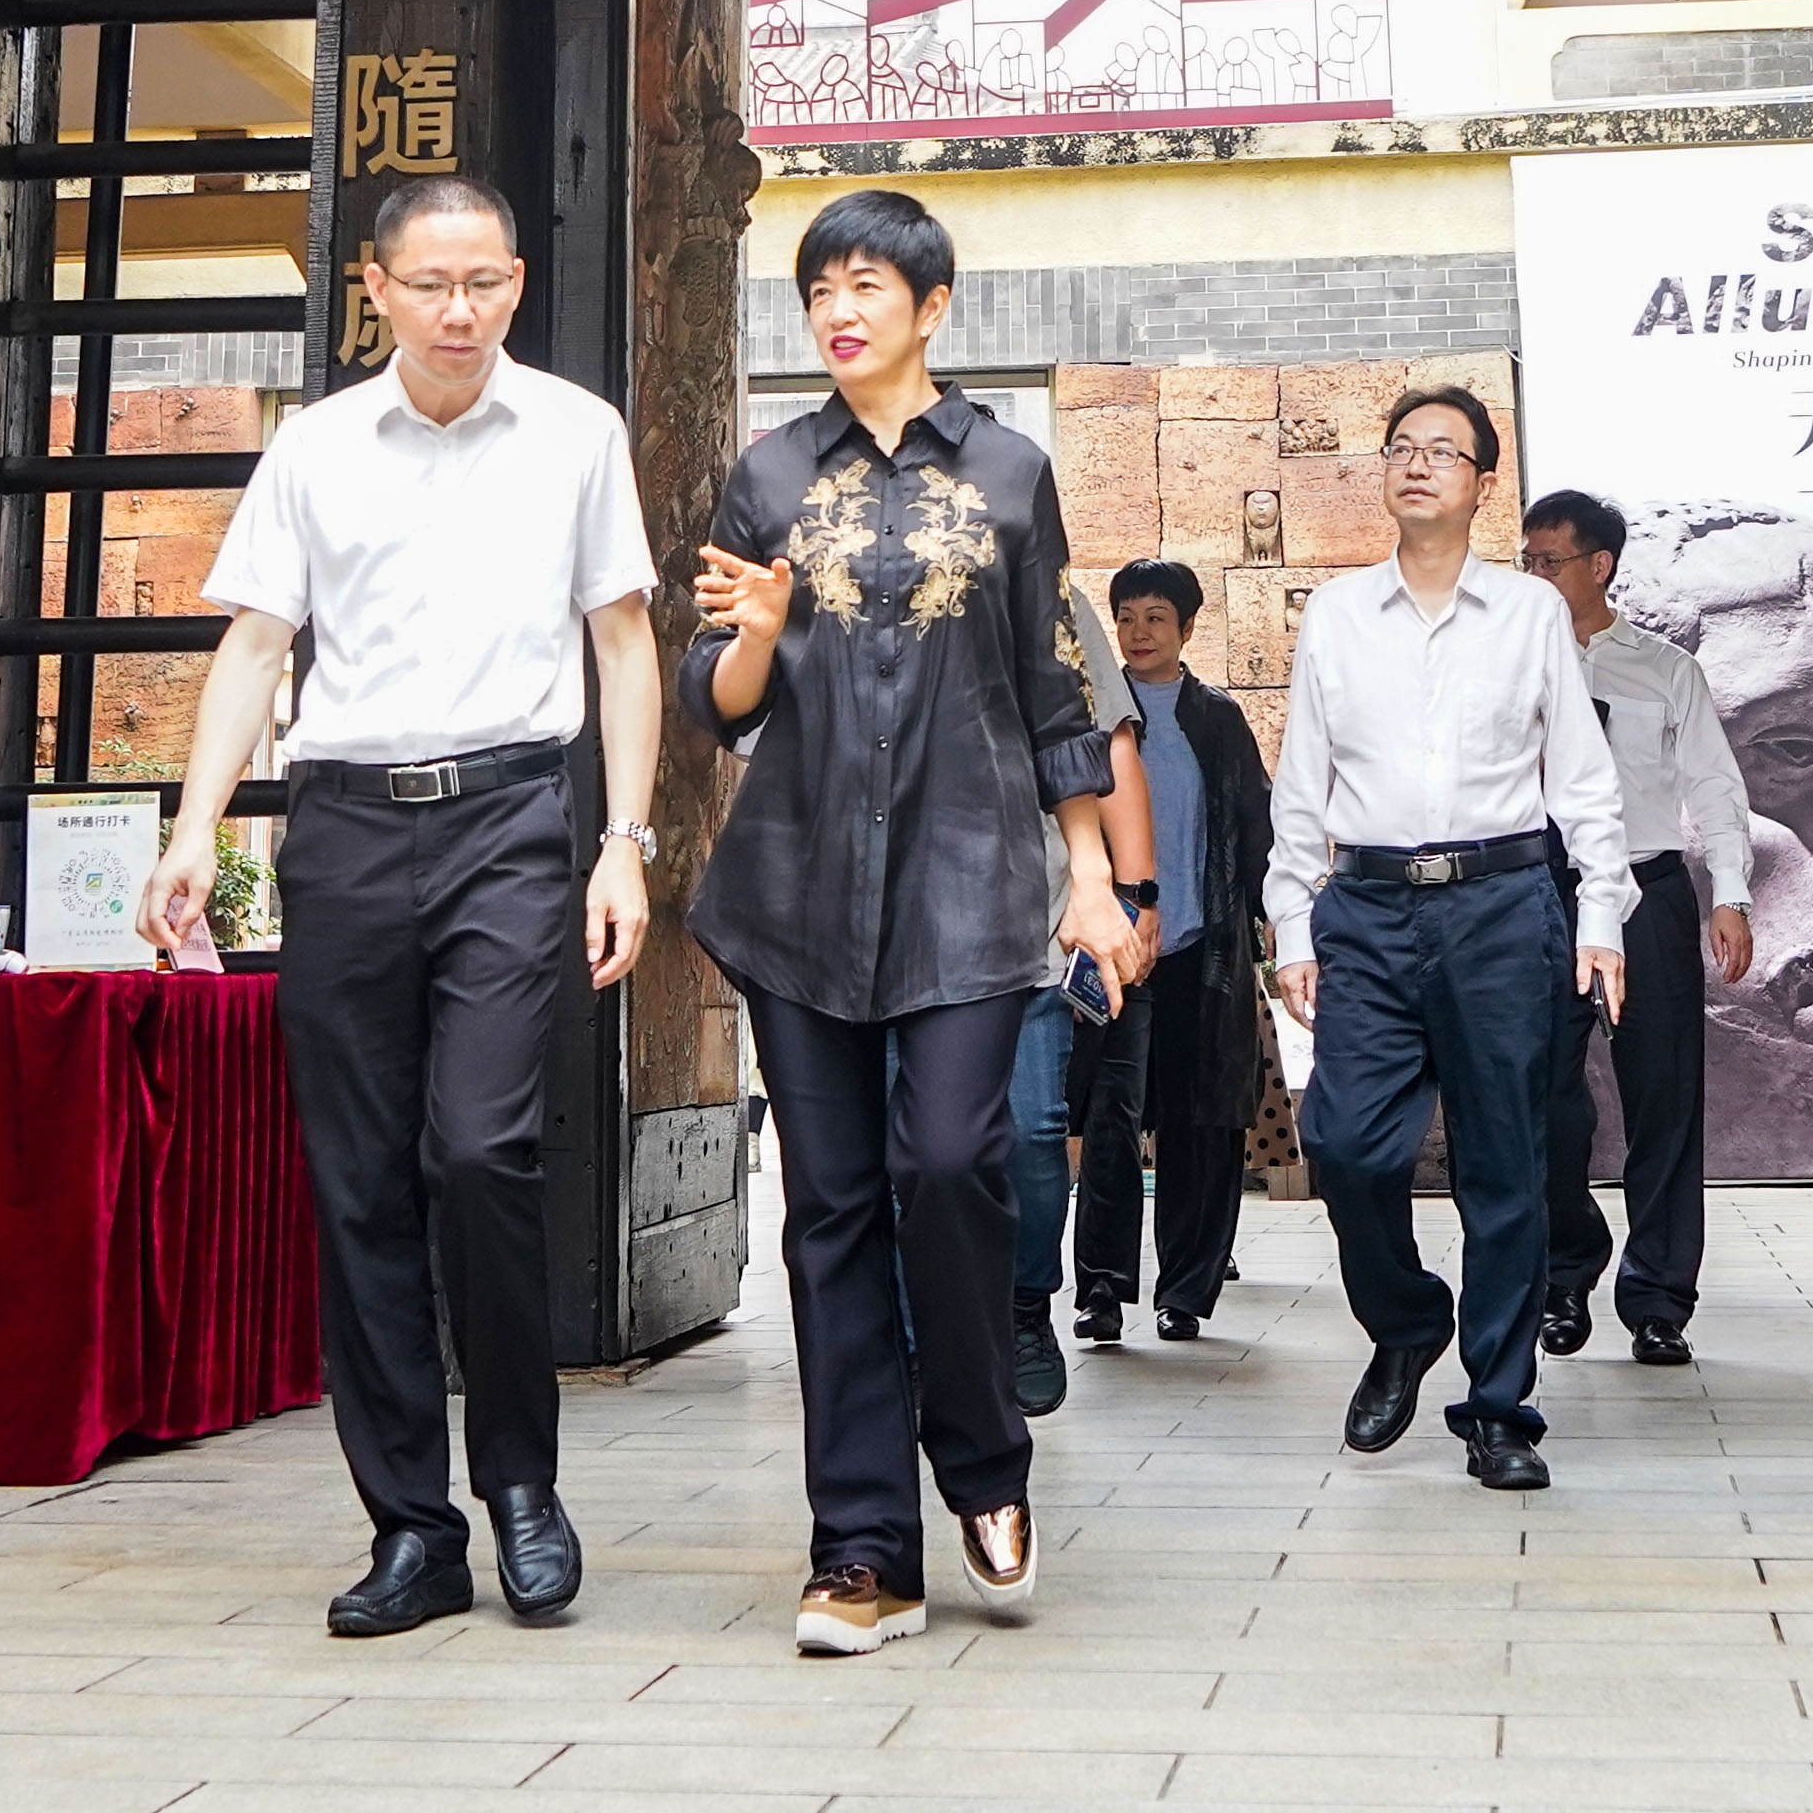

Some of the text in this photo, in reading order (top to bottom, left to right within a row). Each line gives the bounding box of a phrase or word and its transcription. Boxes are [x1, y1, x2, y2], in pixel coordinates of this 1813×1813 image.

[58, 815, 131, 828] 场所通行打卡
